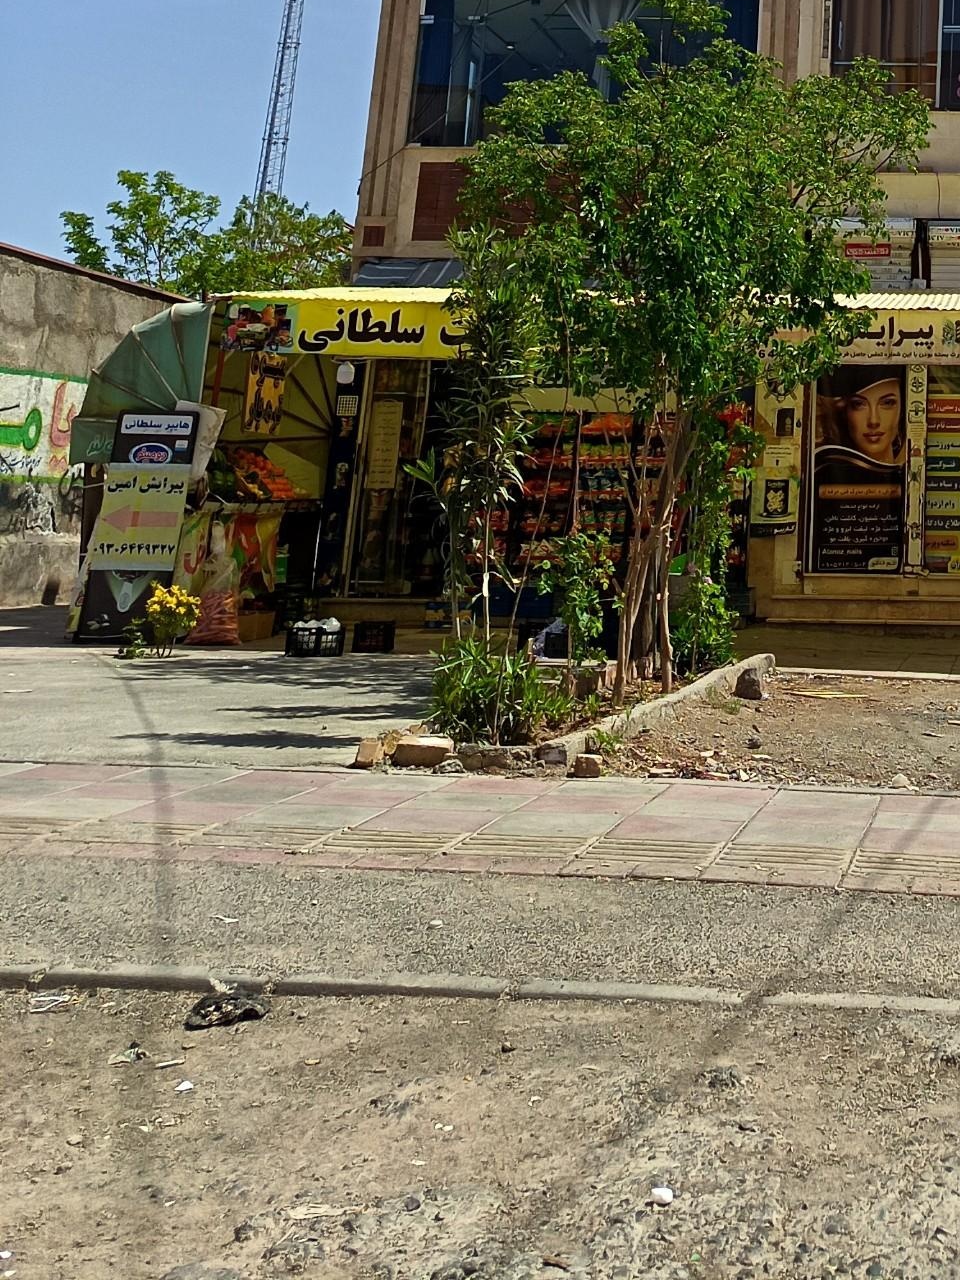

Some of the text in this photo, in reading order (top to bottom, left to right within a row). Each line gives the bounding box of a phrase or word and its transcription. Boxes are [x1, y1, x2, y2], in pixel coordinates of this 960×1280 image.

[298, 308, 425, 352] سلطانی
[125, 419, 190, 432] هایپر سلطانی
[107, 475, 184, 494] پیرایش امین
